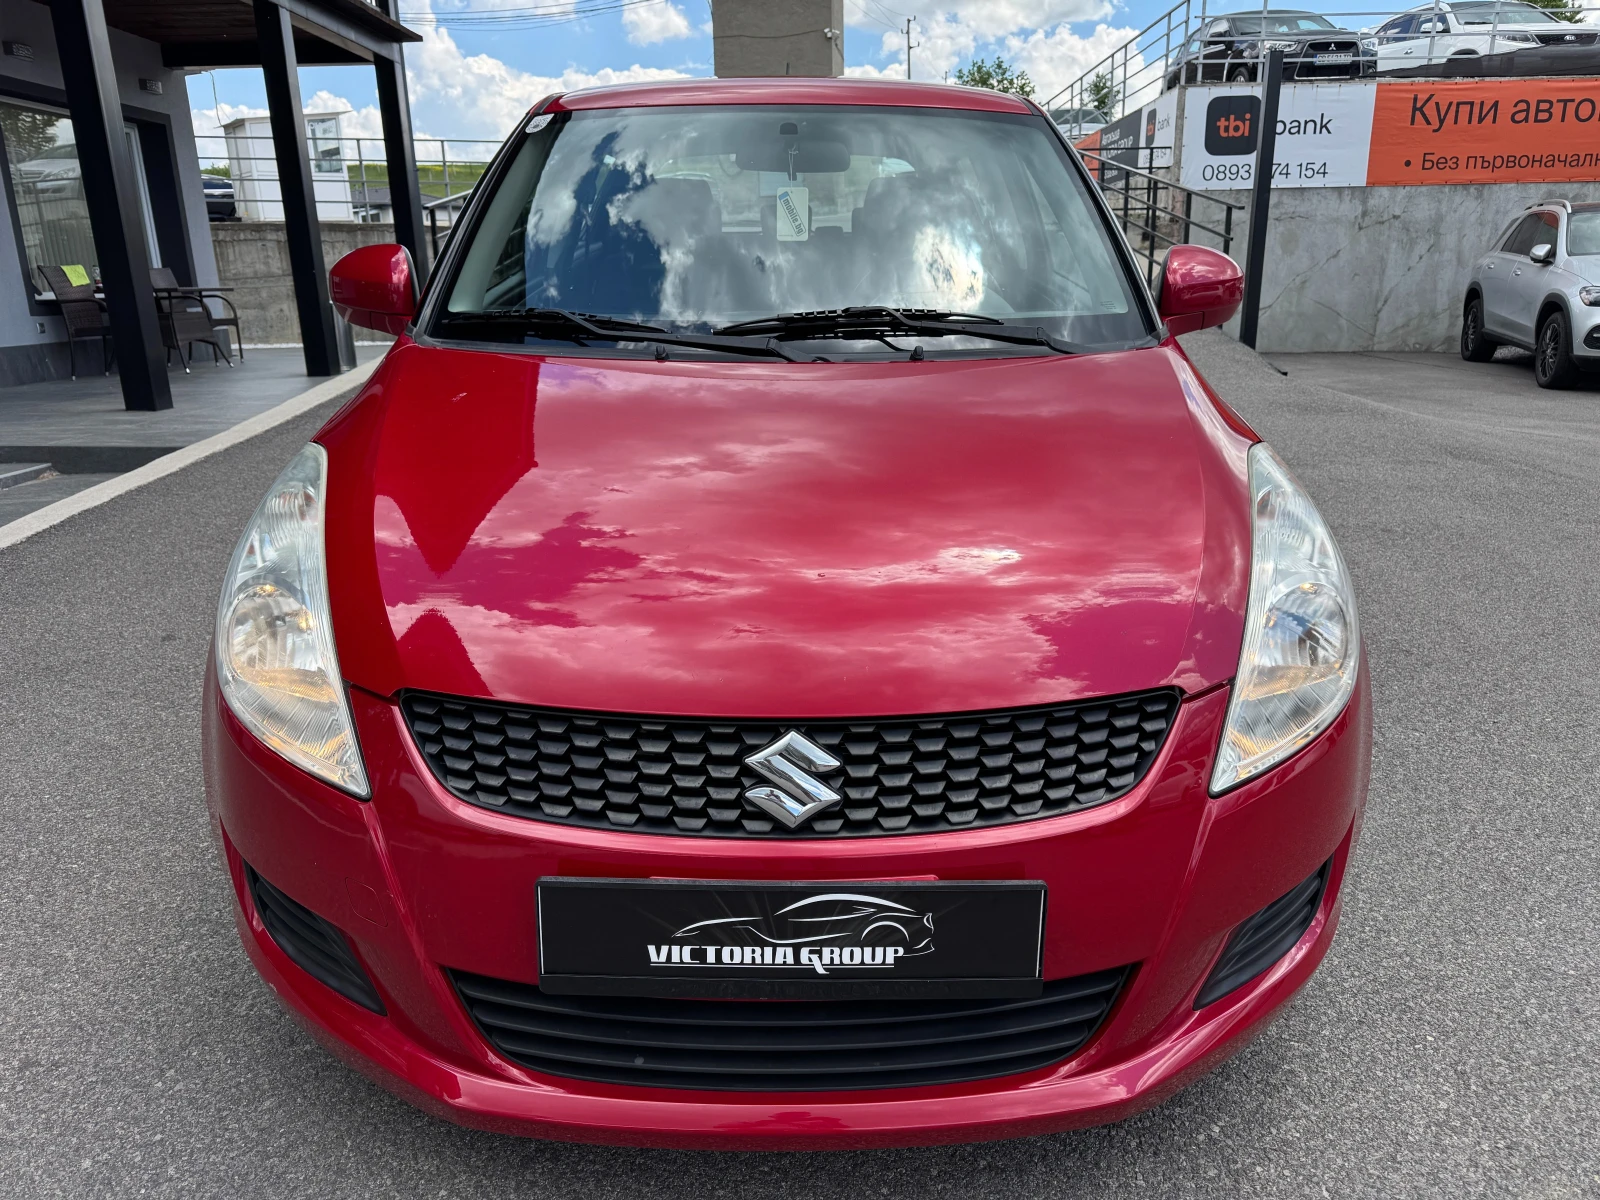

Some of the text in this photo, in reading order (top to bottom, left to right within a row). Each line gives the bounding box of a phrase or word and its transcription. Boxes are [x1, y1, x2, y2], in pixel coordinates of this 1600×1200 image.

[1217, 113, 1251, 137] tbi
[1410, 94, 1600, 132] Купи авто
[1202, 163, 1252, 181] 0893
[1296, 162, 1328, 179] 154
[1422, 152, 1460, 170] Без
[782, 198, 804, 235] mobile.bg
[647, 944, 905, 974] VICTORIA GROUP
